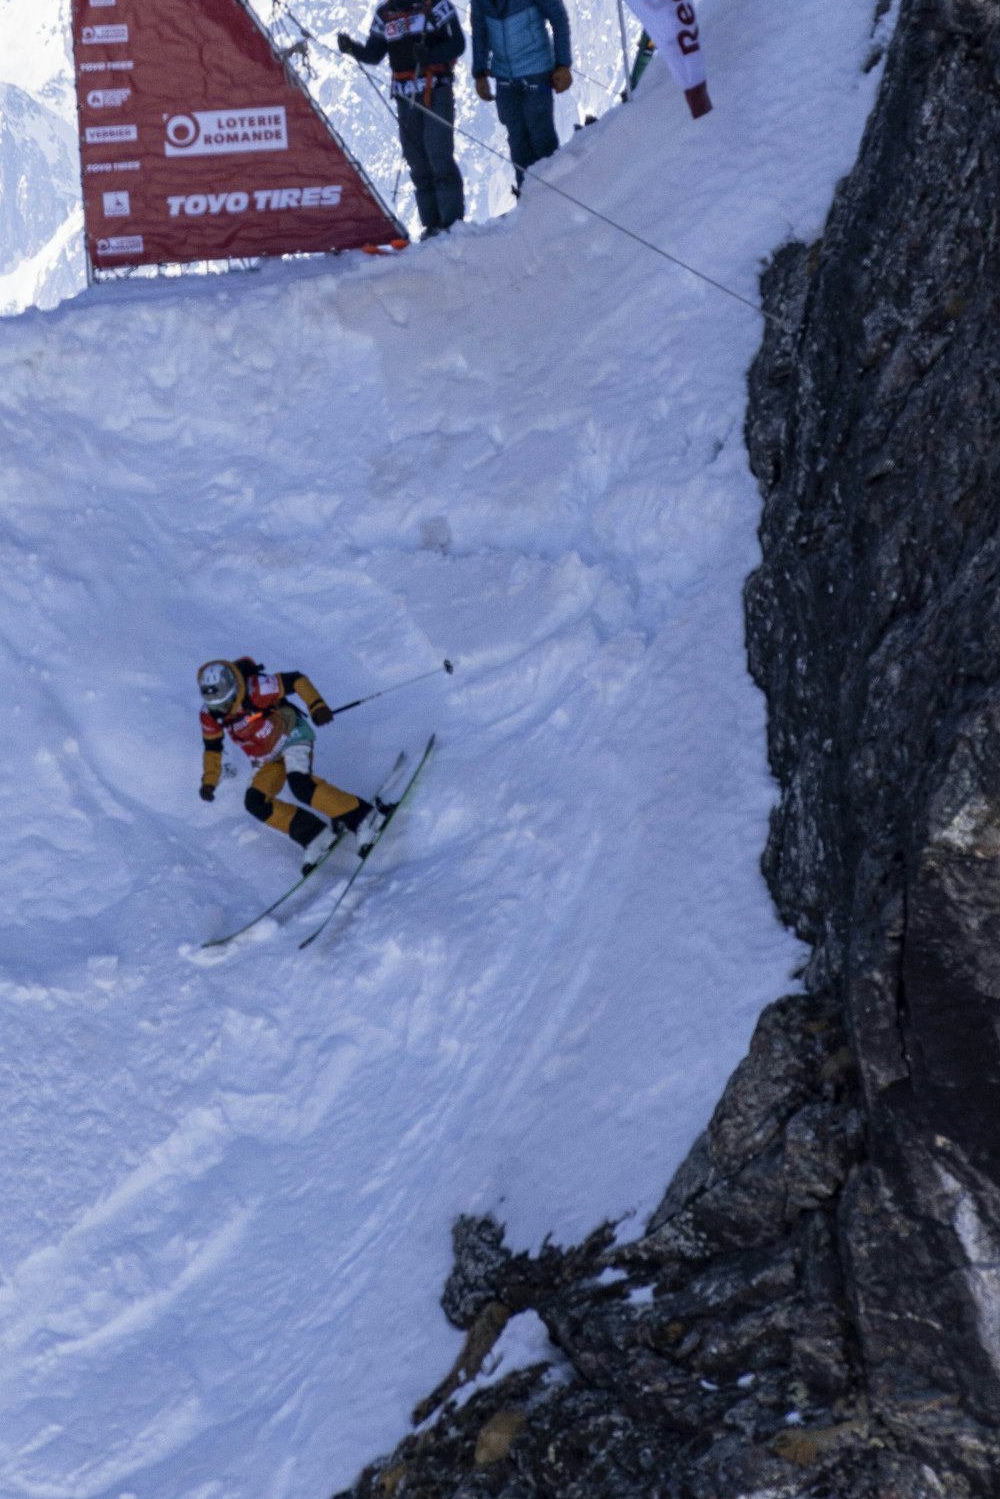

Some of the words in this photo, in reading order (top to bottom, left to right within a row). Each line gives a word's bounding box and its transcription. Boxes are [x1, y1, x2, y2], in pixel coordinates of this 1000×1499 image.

[217, 114, 282, 129] LOTERIE
[203, 130, 282, 145] ROMANDE
[166, 191, 249, 217] TOYO
[253, 185, 343, 211] TIRES
